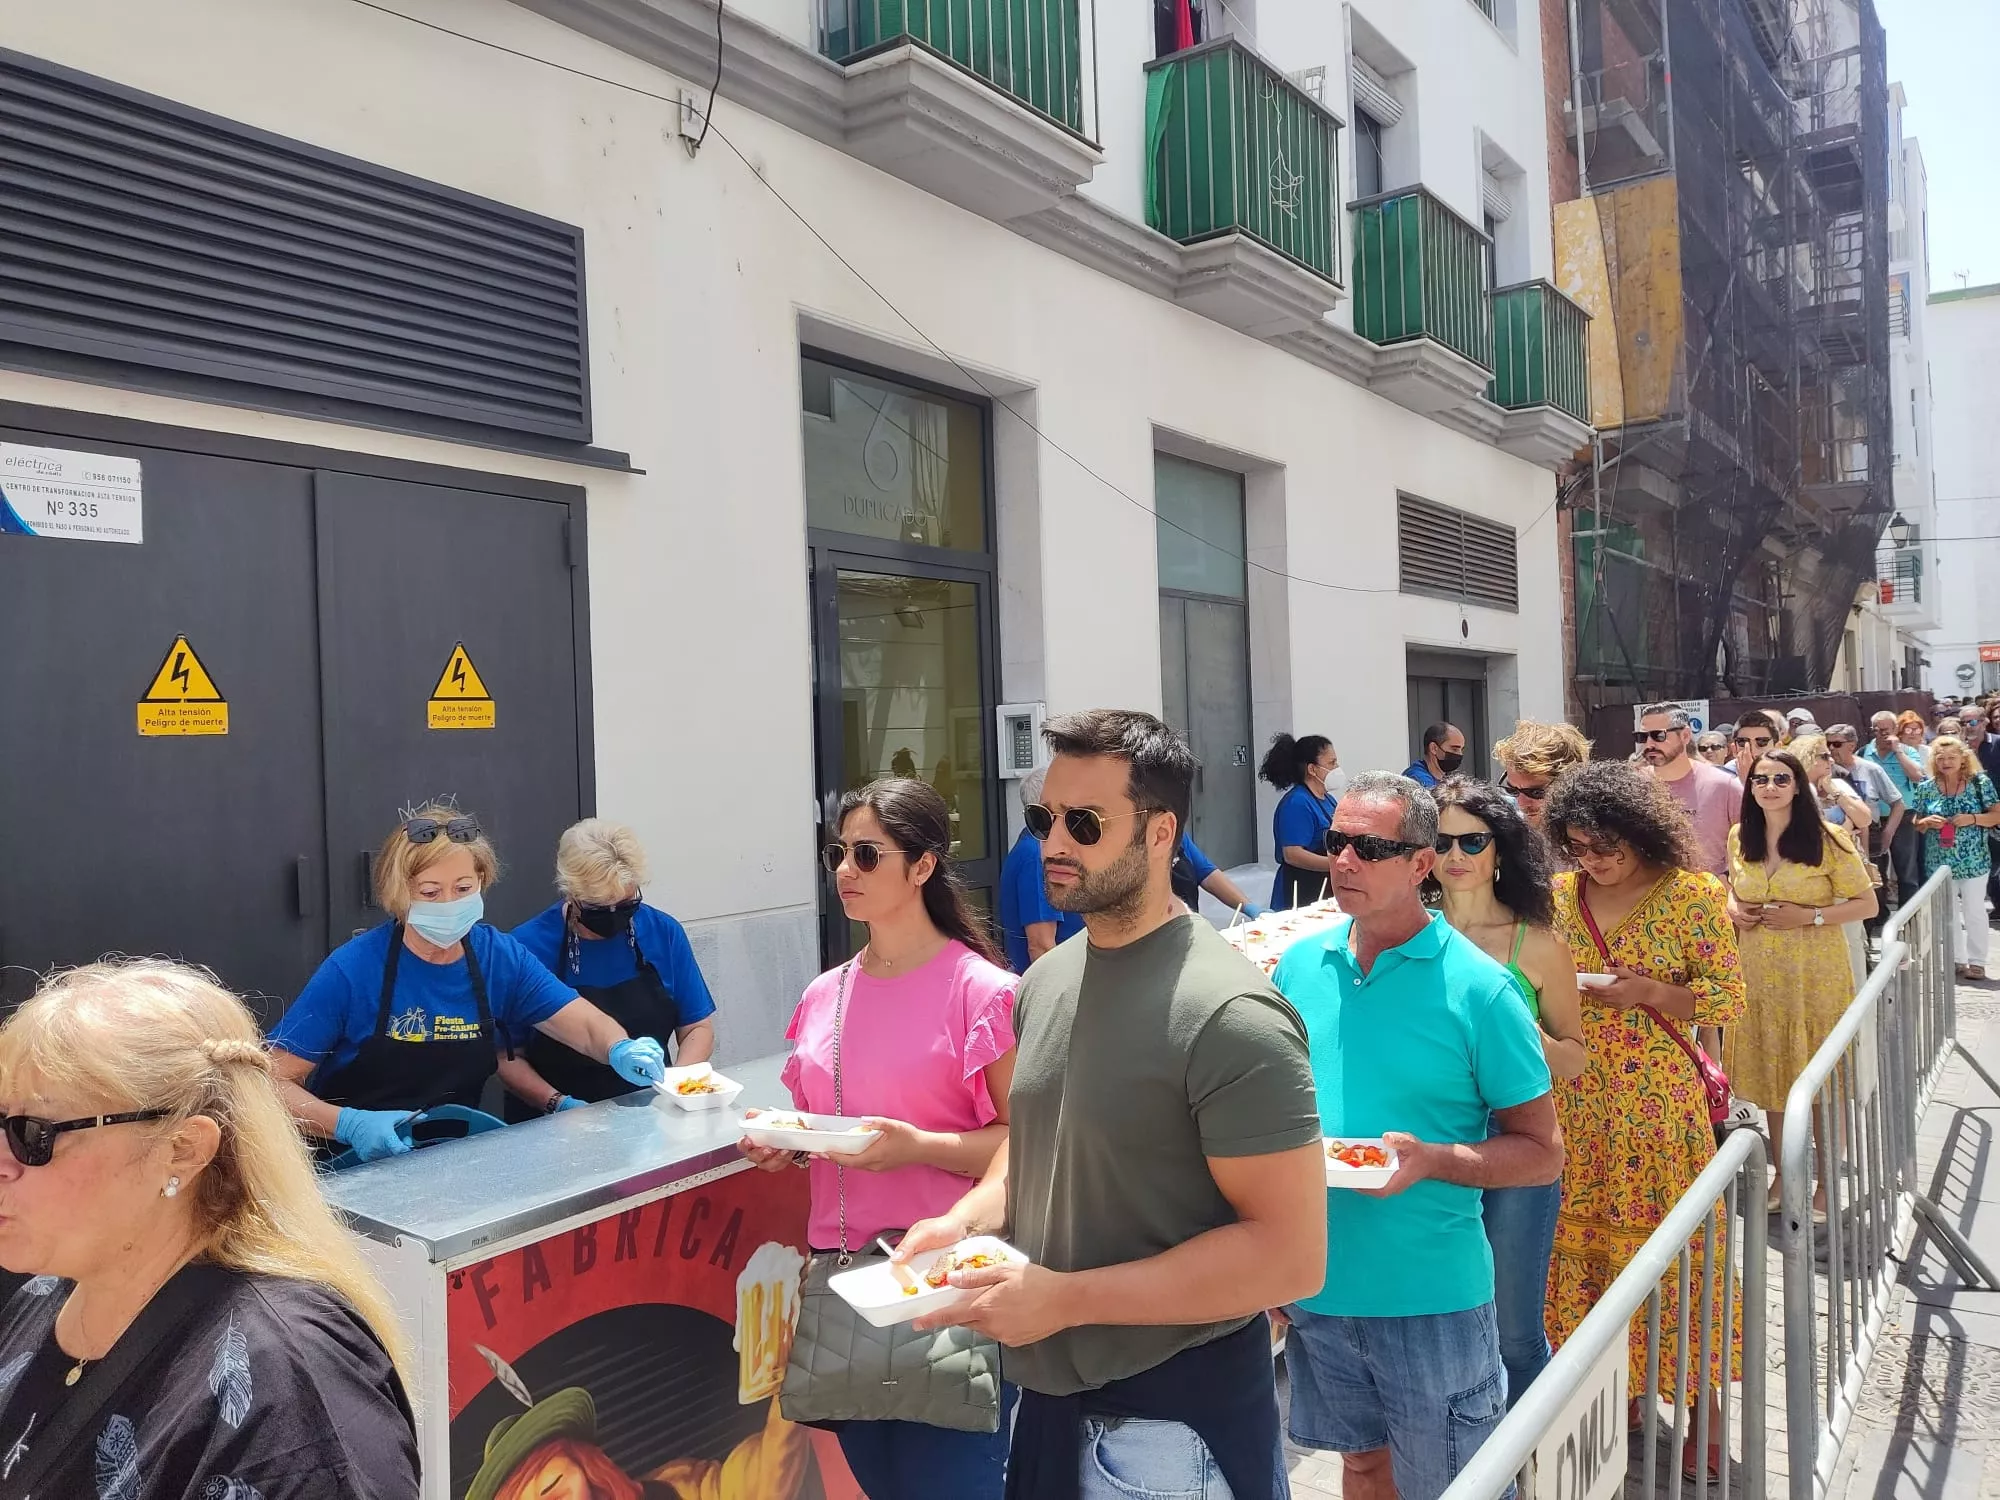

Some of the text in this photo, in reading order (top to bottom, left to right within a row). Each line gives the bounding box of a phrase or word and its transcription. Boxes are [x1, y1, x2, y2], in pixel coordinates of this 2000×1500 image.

[863, 392, 898, 492] 6
[5, 456, 63, 472] eléctrica
[92, 473, 105, 481] 956
[5, 482, 136, 502] CENTRO DE TRANSFORMACION ALTA TENSION
[68, 501, 98, 518] 335
[844, 494, 927, 526] DUPLICADO
[158, 708, 211, 716] Alta tensión
[442, 705, 482, 713] Alta tensión
[432, 714, 457, 722] Peligro
[458, 713, 467, 721] de
[145, 719, 177, 728] Peligro
[179, 718, 191, 726] de
[435, 1015, 464, 1024] Fiesta
[470, 1031, 478, 1039] la
[470, 1196, 744, 1331] FABRICA
